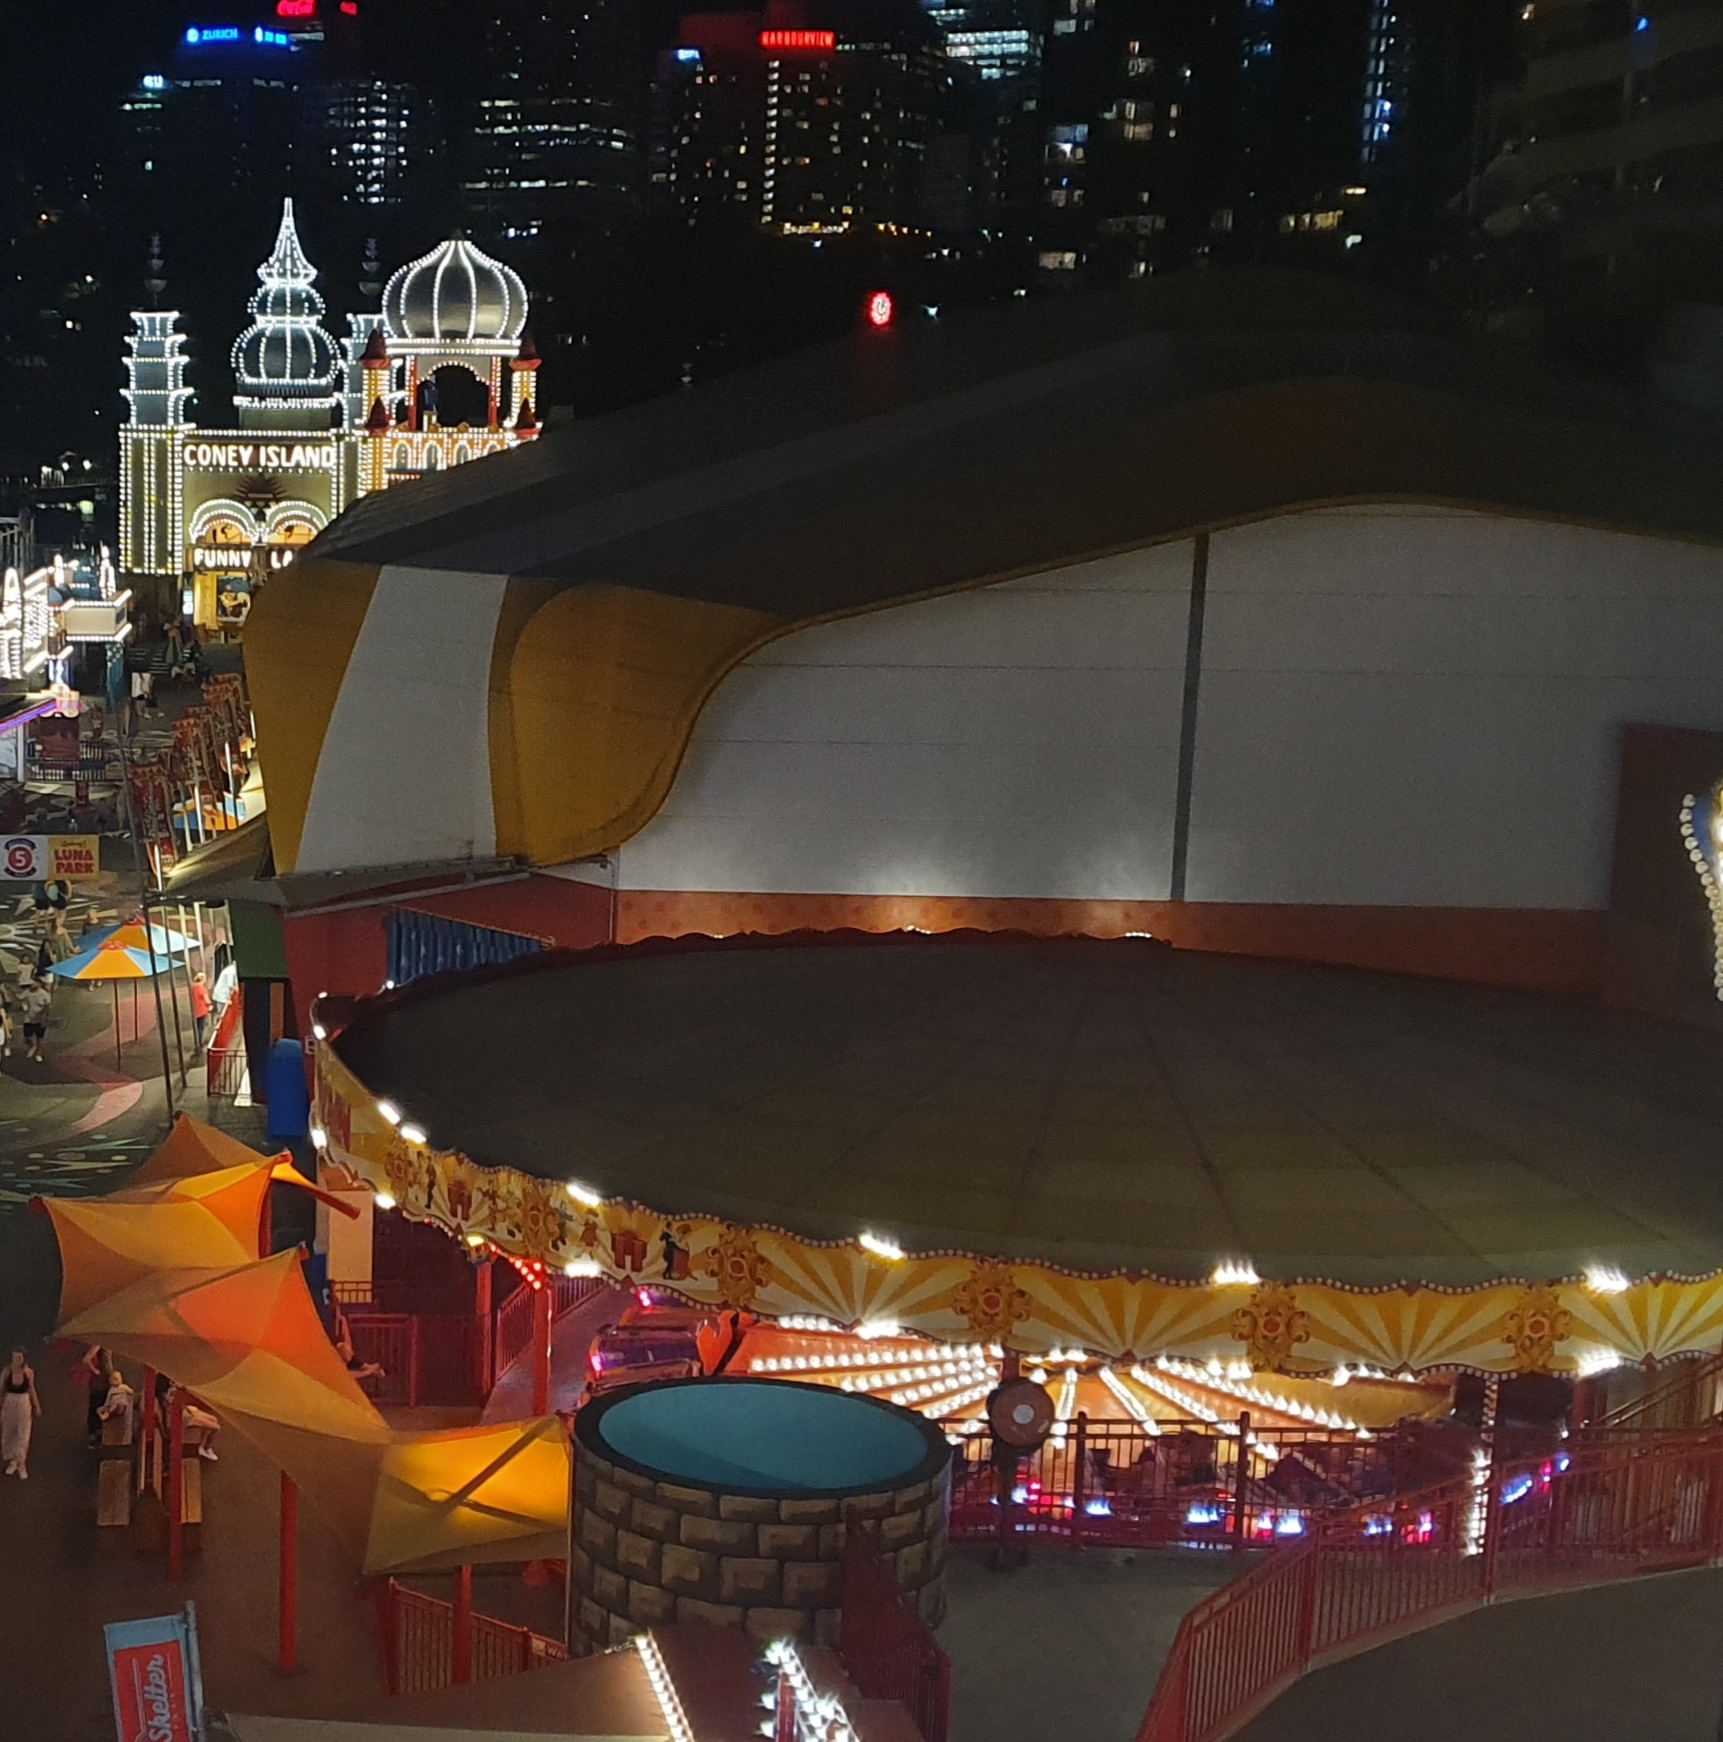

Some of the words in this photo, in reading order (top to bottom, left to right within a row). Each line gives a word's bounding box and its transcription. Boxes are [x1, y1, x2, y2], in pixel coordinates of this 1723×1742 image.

[202, 28, 238, 40] ZURICH
[761, 31, 834, 47] HARBOURVIEW
[183, 444, 253, 467] CONEY
[259, 444, 337, 468] ISLAND
[193, 547, 252, 568] FUNNY
[270, 550, 294, 569] LA
[15, 851, 26, 867] 5
[54, 849, 94, 861] LUNA
[56, 862, 94, 874] PARK
